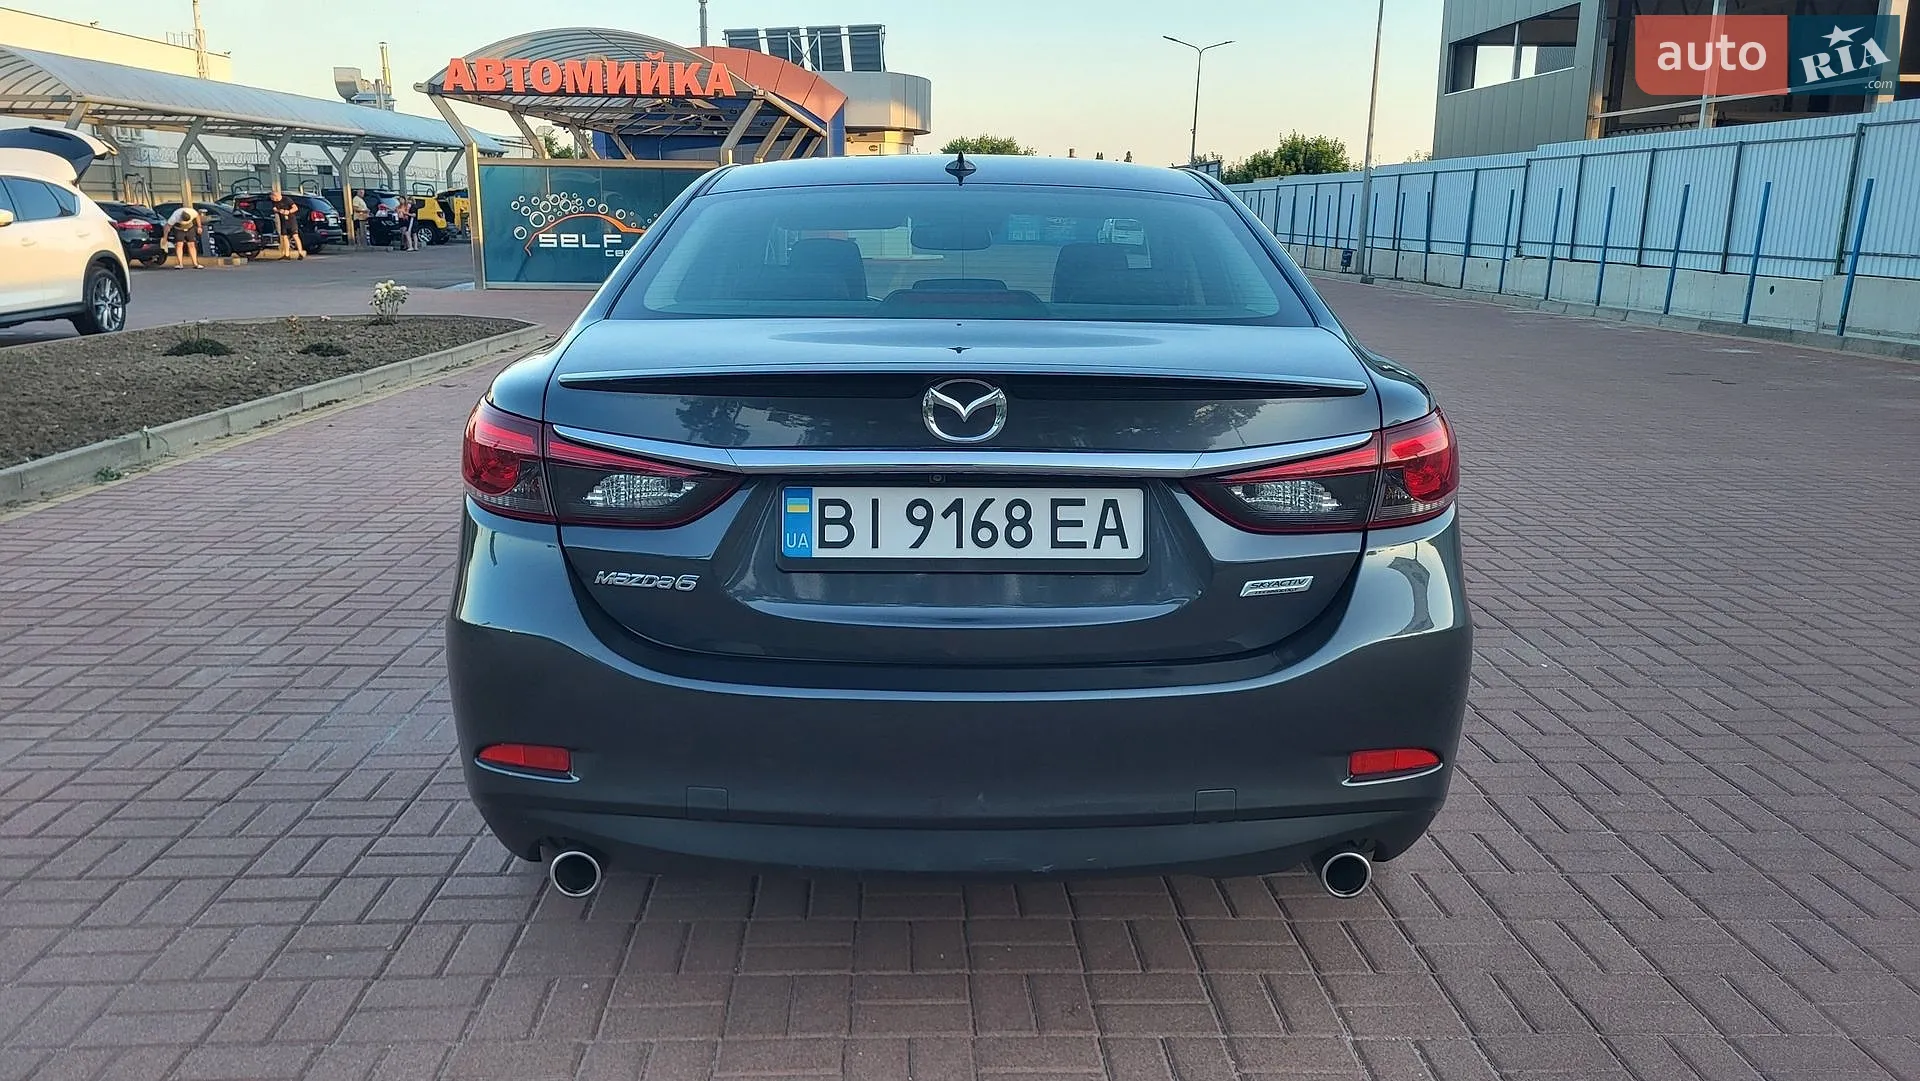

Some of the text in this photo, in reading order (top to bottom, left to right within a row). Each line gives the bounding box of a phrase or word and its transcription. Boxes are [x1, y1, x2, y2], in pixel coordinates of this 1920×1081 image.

[443, 52, 736, 96] АВТОМИЙКА
[817, 498, 1129, 549] BI 9168 EA
[786, 533, 809, 548] UA
[1250, 579, 1306, 588] SKYACTIV
